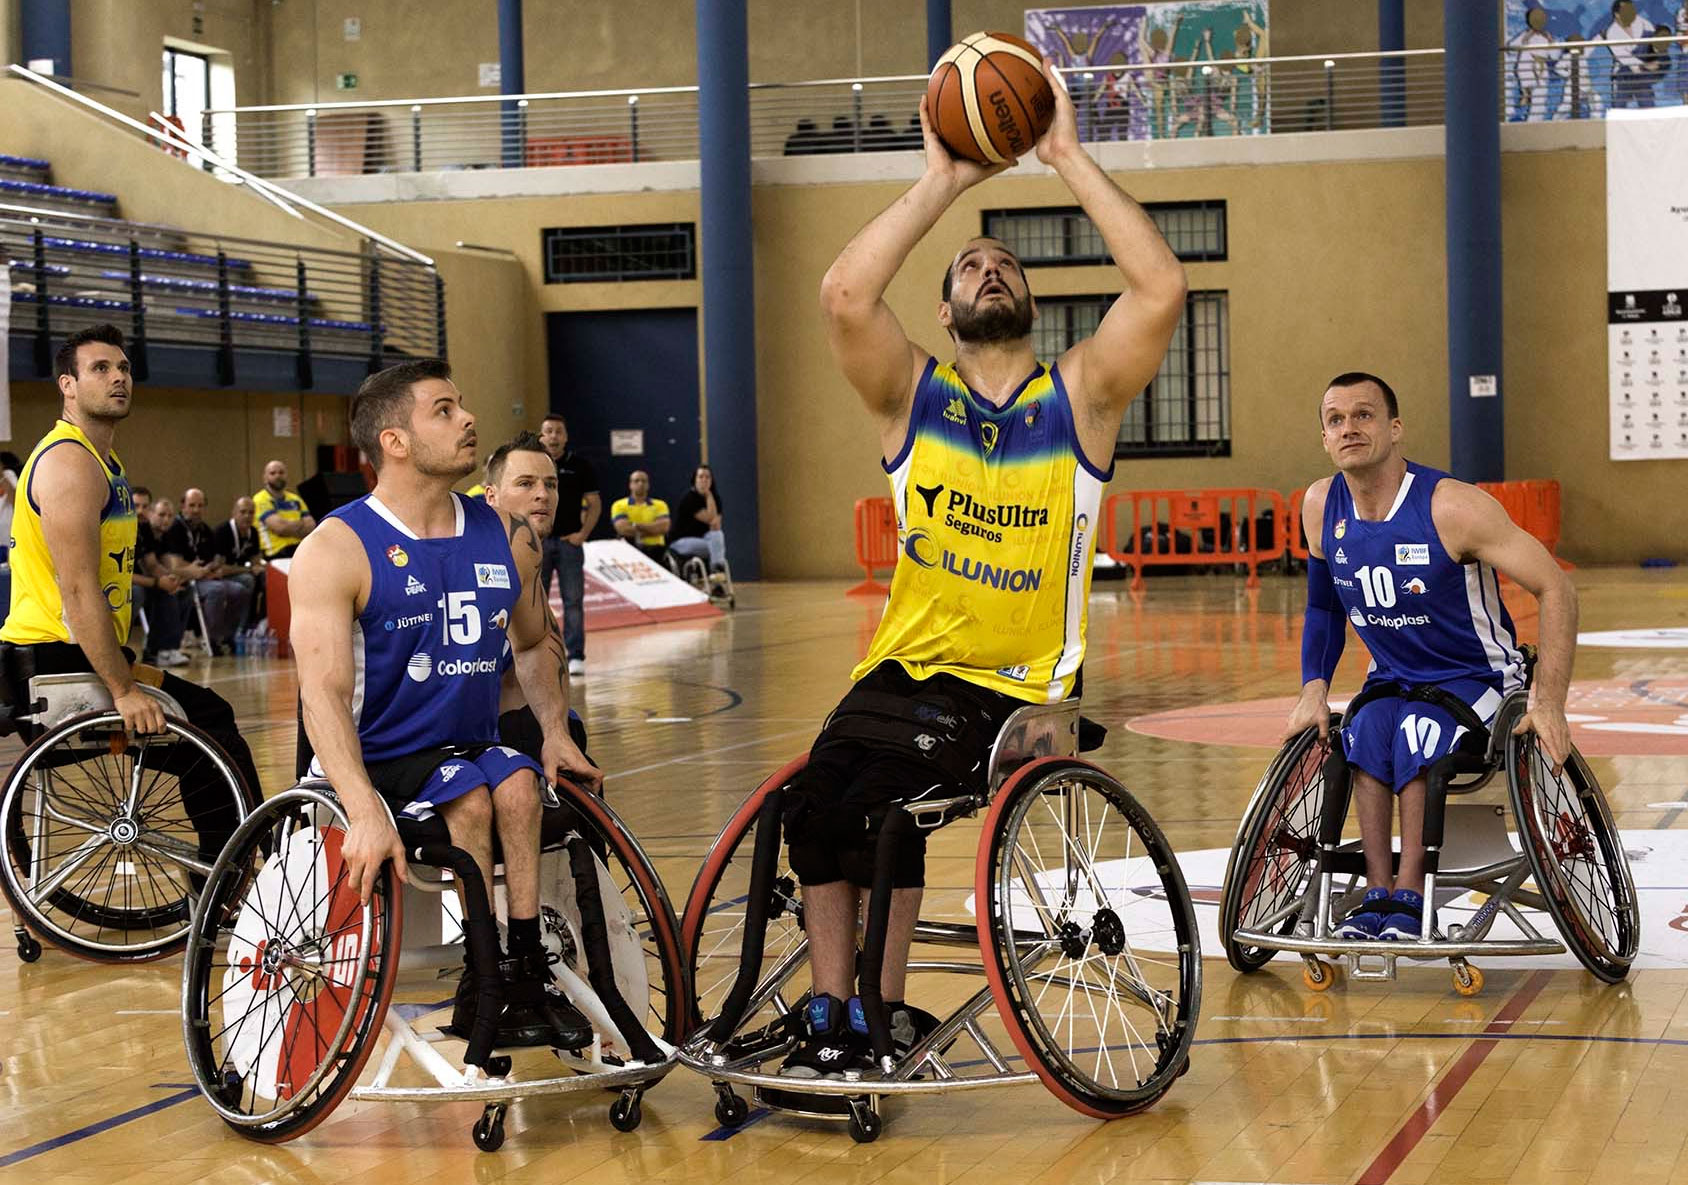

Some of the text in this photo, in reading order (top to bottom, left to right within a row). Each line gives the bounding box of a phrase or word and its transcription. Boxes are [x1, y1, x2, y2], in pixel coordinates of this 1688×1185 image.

[989, 90, 1025, 153] molten
[980, 420, 999, 458] 9
[945, 513, 1002, 543] Seguros
[947, 489, 1048, 528] PlusUltra
[942, 549, 1042, 593] ILUNION
[1071, 532, 1084, 576] ILUNION
[404, 582, 428, 596] PEAK
[1354, 565, 1397, 608] 10
[437, 591, 482, 646] 15
[1367, 613, 1431, 630] Coloplast
[437, 657, 497, 677] Coloplast
[1400, 713, 1441, 759] 10
[817, 1047, 844, 1062] RGK
